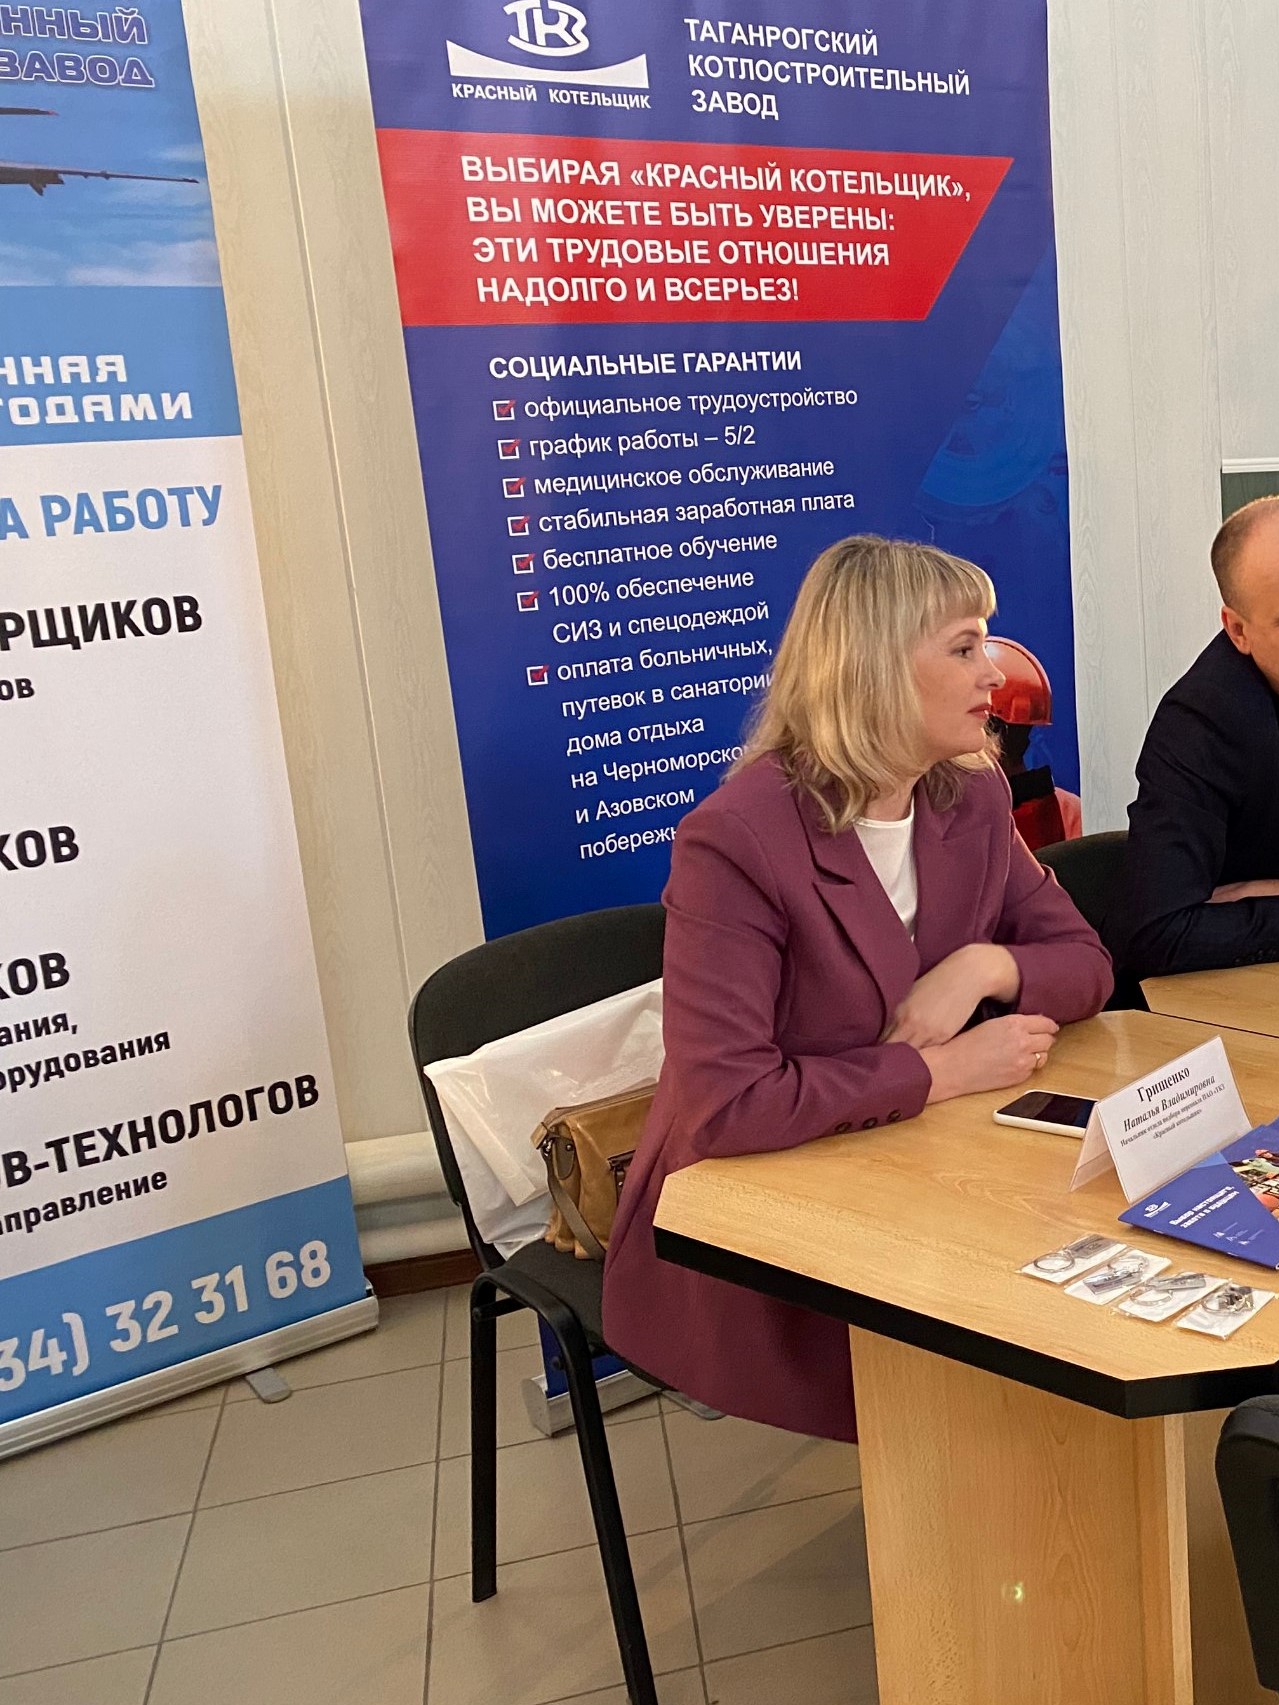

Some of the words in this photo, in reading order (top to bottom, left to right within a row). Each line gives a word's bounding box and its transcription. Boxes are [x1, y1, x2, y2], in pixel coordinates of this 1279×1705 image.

[0, 5, 148, 45] ННЫЙ
[684, 18, 877, 56] ТАГАНРОГСКИЙ
[0, 49, 155, 87] ЗАВОД
[689, 54, 969, 95] КОТЛОСТРОИТЕЛЬНЫЙ
[452, 83, 537, 101] КРАСНЫЙ
[549, 89, 651, 110] КОТЕЛЬЩИК
[692, 89, 779, 120] ЗАВОД
[461, 156, 620, 185] ВЫБИРАЯ
[631, 161, 782, 191] «КРАСНЫЙ
[790, 169, 970, 202] КОТЕЛЬЩИК»,
[467, 197, 521, 222] ВЫ
[531, 198, 662, 225] МОЖЕТЕ
[670, 202, 753, 227] БЫТЬ
[759, 204, 894, 230] УВЕРЕНЫ:
[473, 237, 538, 262] ЭТИ
[546, 238, 711, 268] ТРУДОВЫЕ
[719, 240, 889, 265] ОТНОШЕНИЯ
[477, 277, 627, 306] НАДОЛГО
[636, 278, 656, 301] И
[665, 277, 798, 301] ВСЕРЬЕЗ!
[489, 353, 676, 381] СОЦИАЛЬНЫЕ
[683, 351, 801, 373] ГАРАНТИИ
[0, 392, 193, 425] ОДАМИ
[525, 396, 681, 421] официальное
[687, 387, 857, 415] трудоустройство
[530, 433, 613, 461] график
[618, 428, 698, 456] работы
[725, 425, 755, 445] 5/2
[534, 470, 682, 496] медицинское
[689, 461, 834, 485] обслуживание
[40, 484, 222, 537] РАБОТУ
[539, 507, 669, 532] стабильная
[676, 497, 795, 524] заработная
[801, 494, 854, 511] плата
[543, 544, 673, 570] бесплатное
[679, 535, 777, 559] обучение
[549, 581, 610, 606] 100%
[616, 572, 754, 599] обеспечение
[0, 595, 203, 651] РЩИКОВ
[553, 619, 602, 643] СИЗ
[609, 622, 621, 637] и
[628, 601, 769, 634] спецодеждой
[557, 657, 633, 680] оплата
[639, 640, 772, 669] больничных,
[562, 690, 646, 720] путевок
[652, 689, 664, 703] в
[567, 730, 622, 757] дома
[628, 718, 704, 743] отдыха
[571, 771, 598, 788] на
[603, 746, 744, 782] Черноморско
[576, 808, 589, 824] и
[595, 789, 694, 820] Азовском
[1124, 1105, 1160, 1132] Наталья
[1162, 1075, 1216, 1111] Владимировна
[1137, 1067, 1190, 1102] Грищенко
[0, 1073, 320, 1189] В-ТЕХНОЛОГОВ
[0, 1168, 168, 1237] правление
[0, 1312, 90, 1392] 34)
[105, 1291, 179, 1353] 32
[190, 1264, 249, 1325] 31
[264, 1239, 332, 1301] 68
